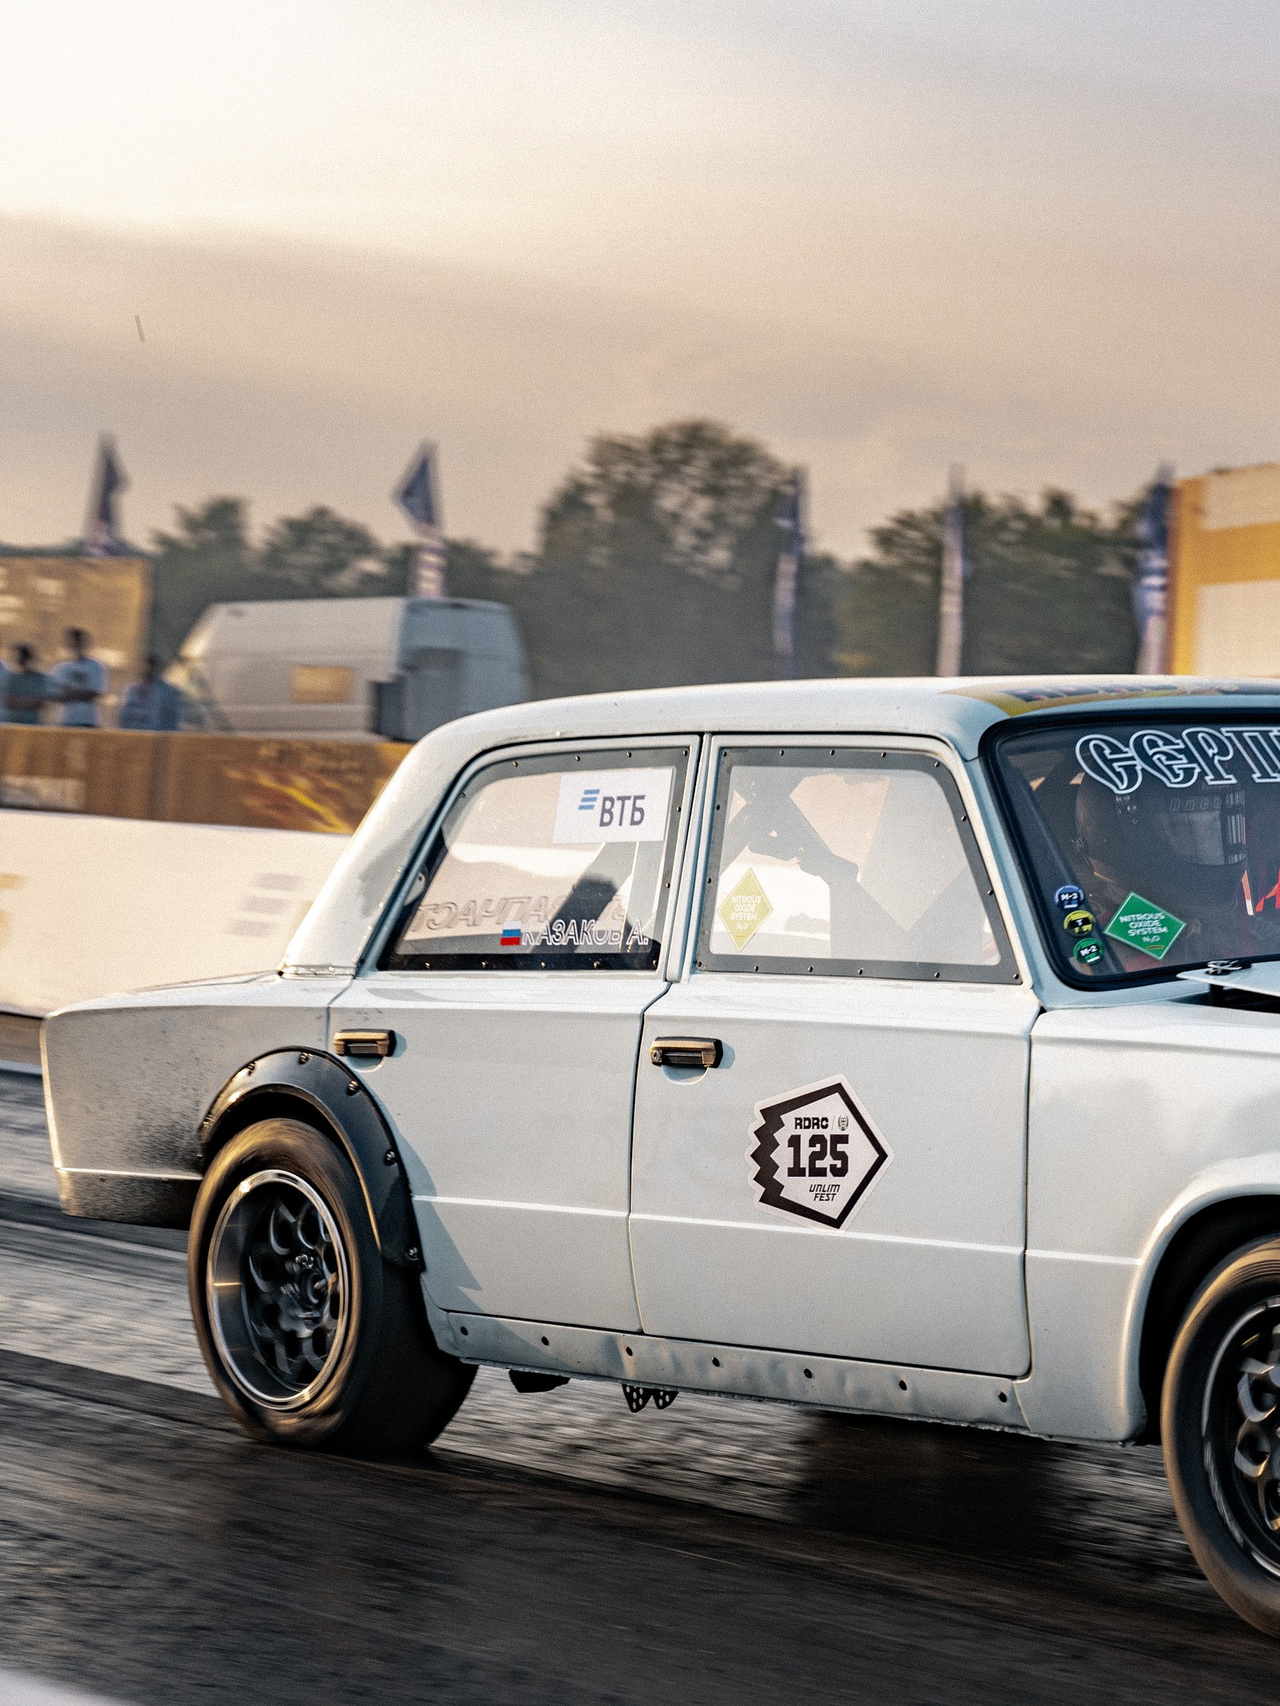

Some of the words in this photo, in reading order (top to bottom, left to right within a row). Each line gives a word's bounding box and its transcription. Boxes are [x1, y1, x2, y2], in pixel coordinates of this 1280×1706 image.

[599, 795, 645, 827] ВТБ
[1119, 912, 1165, 923] NITROUS
[1128, 919, 1162, 929] OXIDE
[521, 919, 622, 946] КАЗАКОВ
[1127, 926, 1169, 937] SYSTEM
[794, 1117, 829, 1130] RDRC
[787, 1134, 849, 1177] 125
[813, 1193, 837, 1201] FEST
